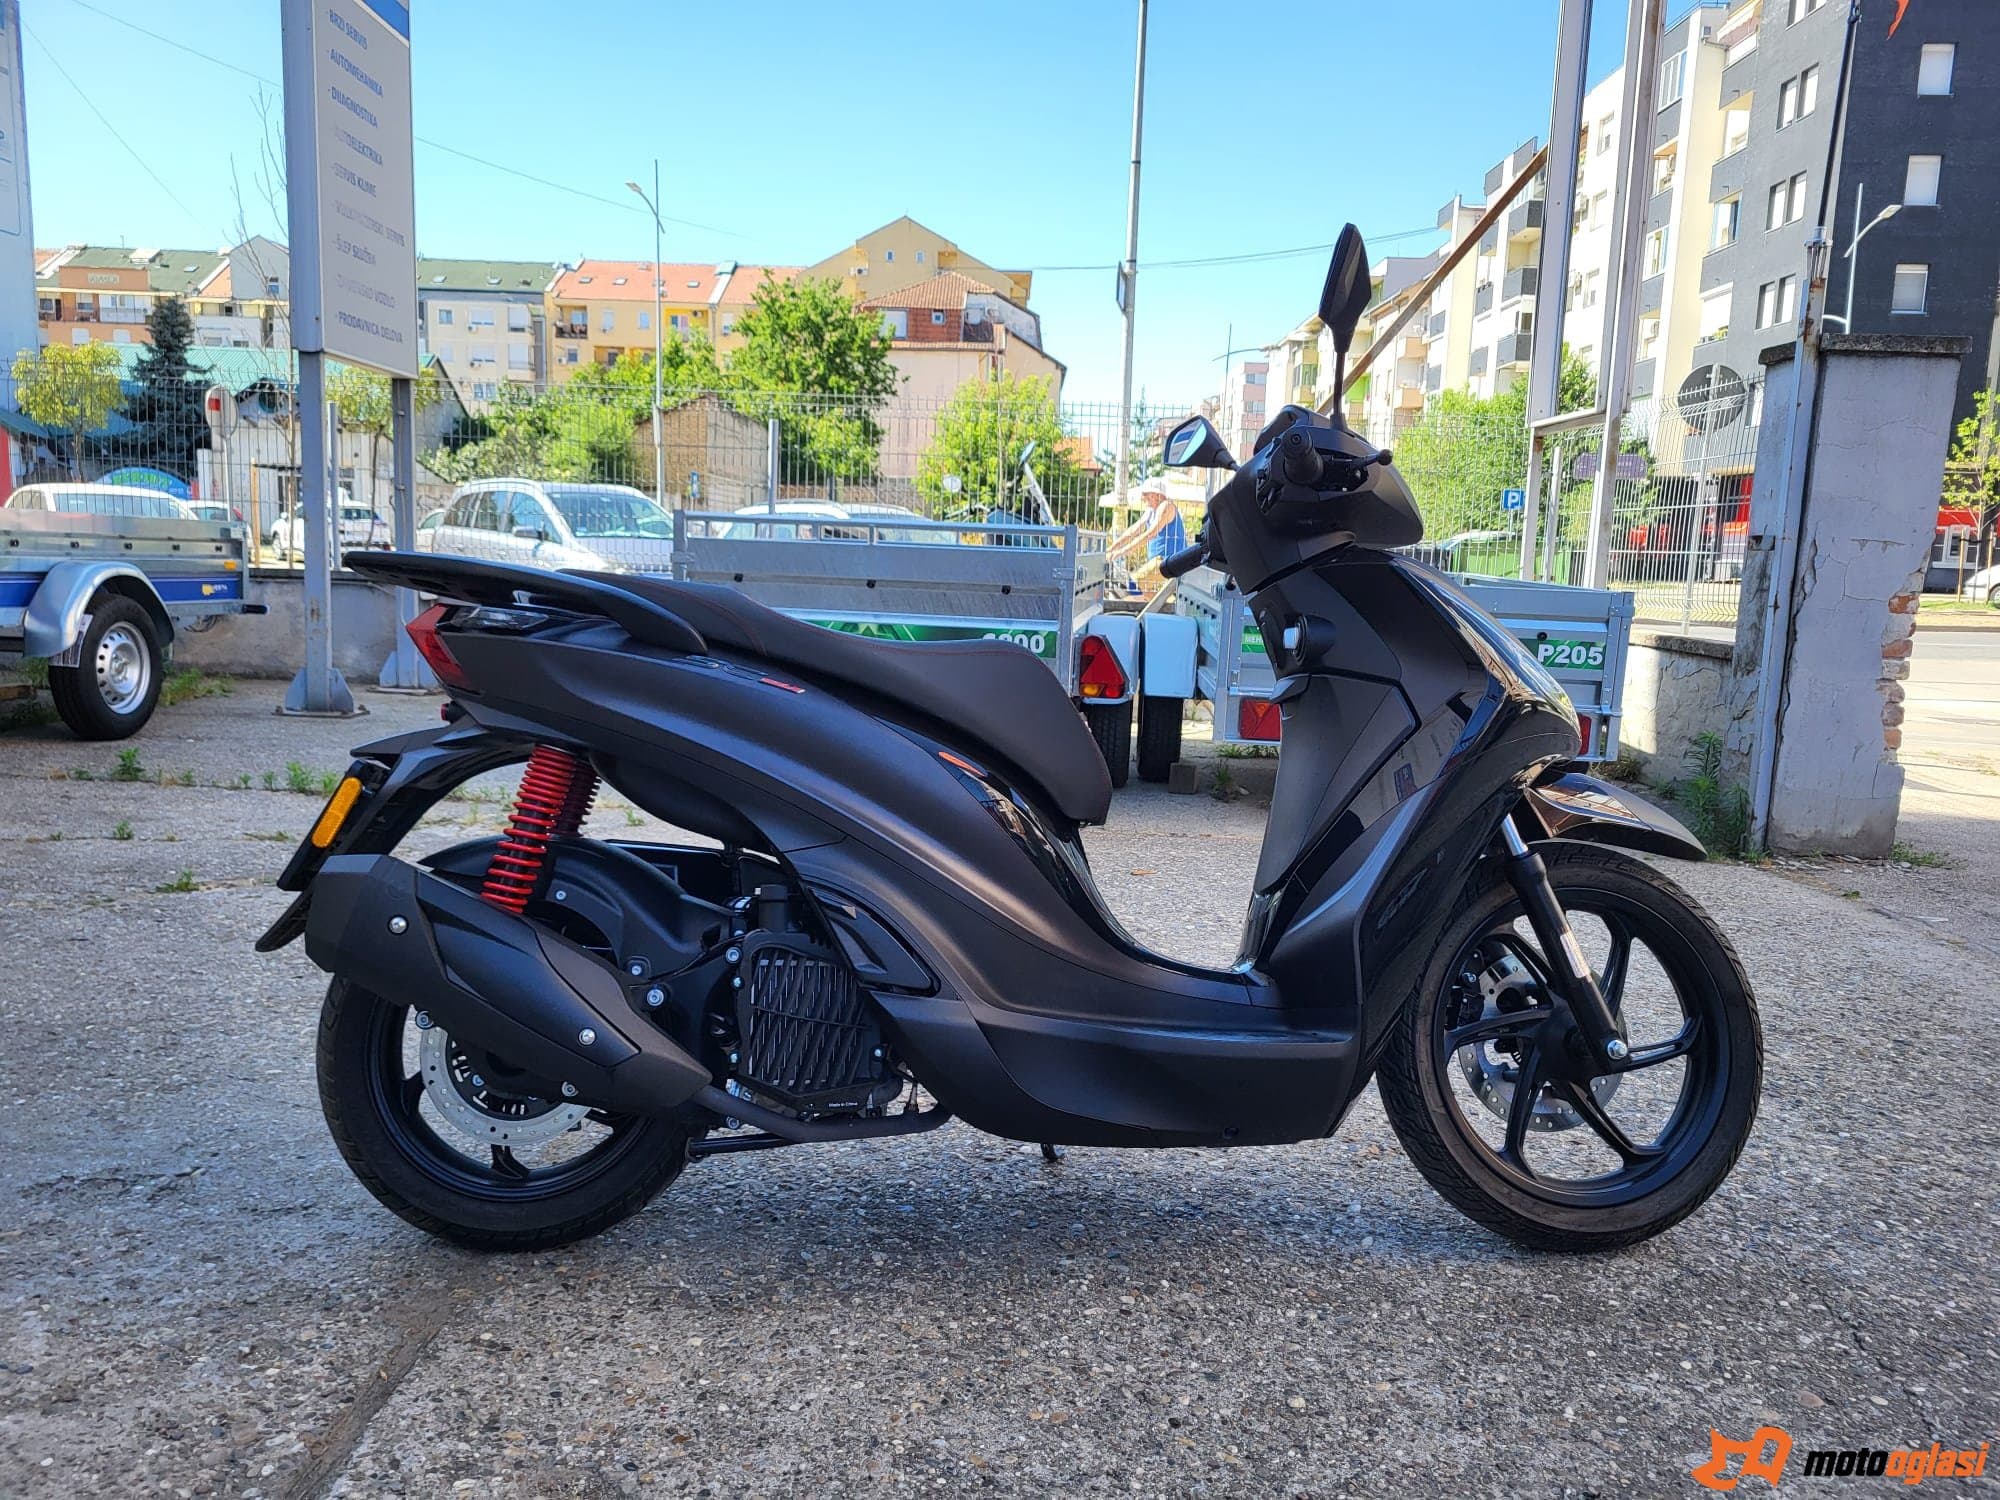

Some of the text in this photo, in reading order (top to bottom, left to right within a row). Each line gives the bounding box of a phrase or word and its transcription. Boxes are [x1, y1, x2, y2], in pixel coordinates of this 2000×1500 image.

[346, 22, 368, 50] SERVIS
[330, 49, 384, 97] AUTOMEHANIKA
[338, 311, 403, 344] PRODAVNICA DELOVA
[1507, 491, 1519, 507] P
[1537, 643, 1604, 666] P205
